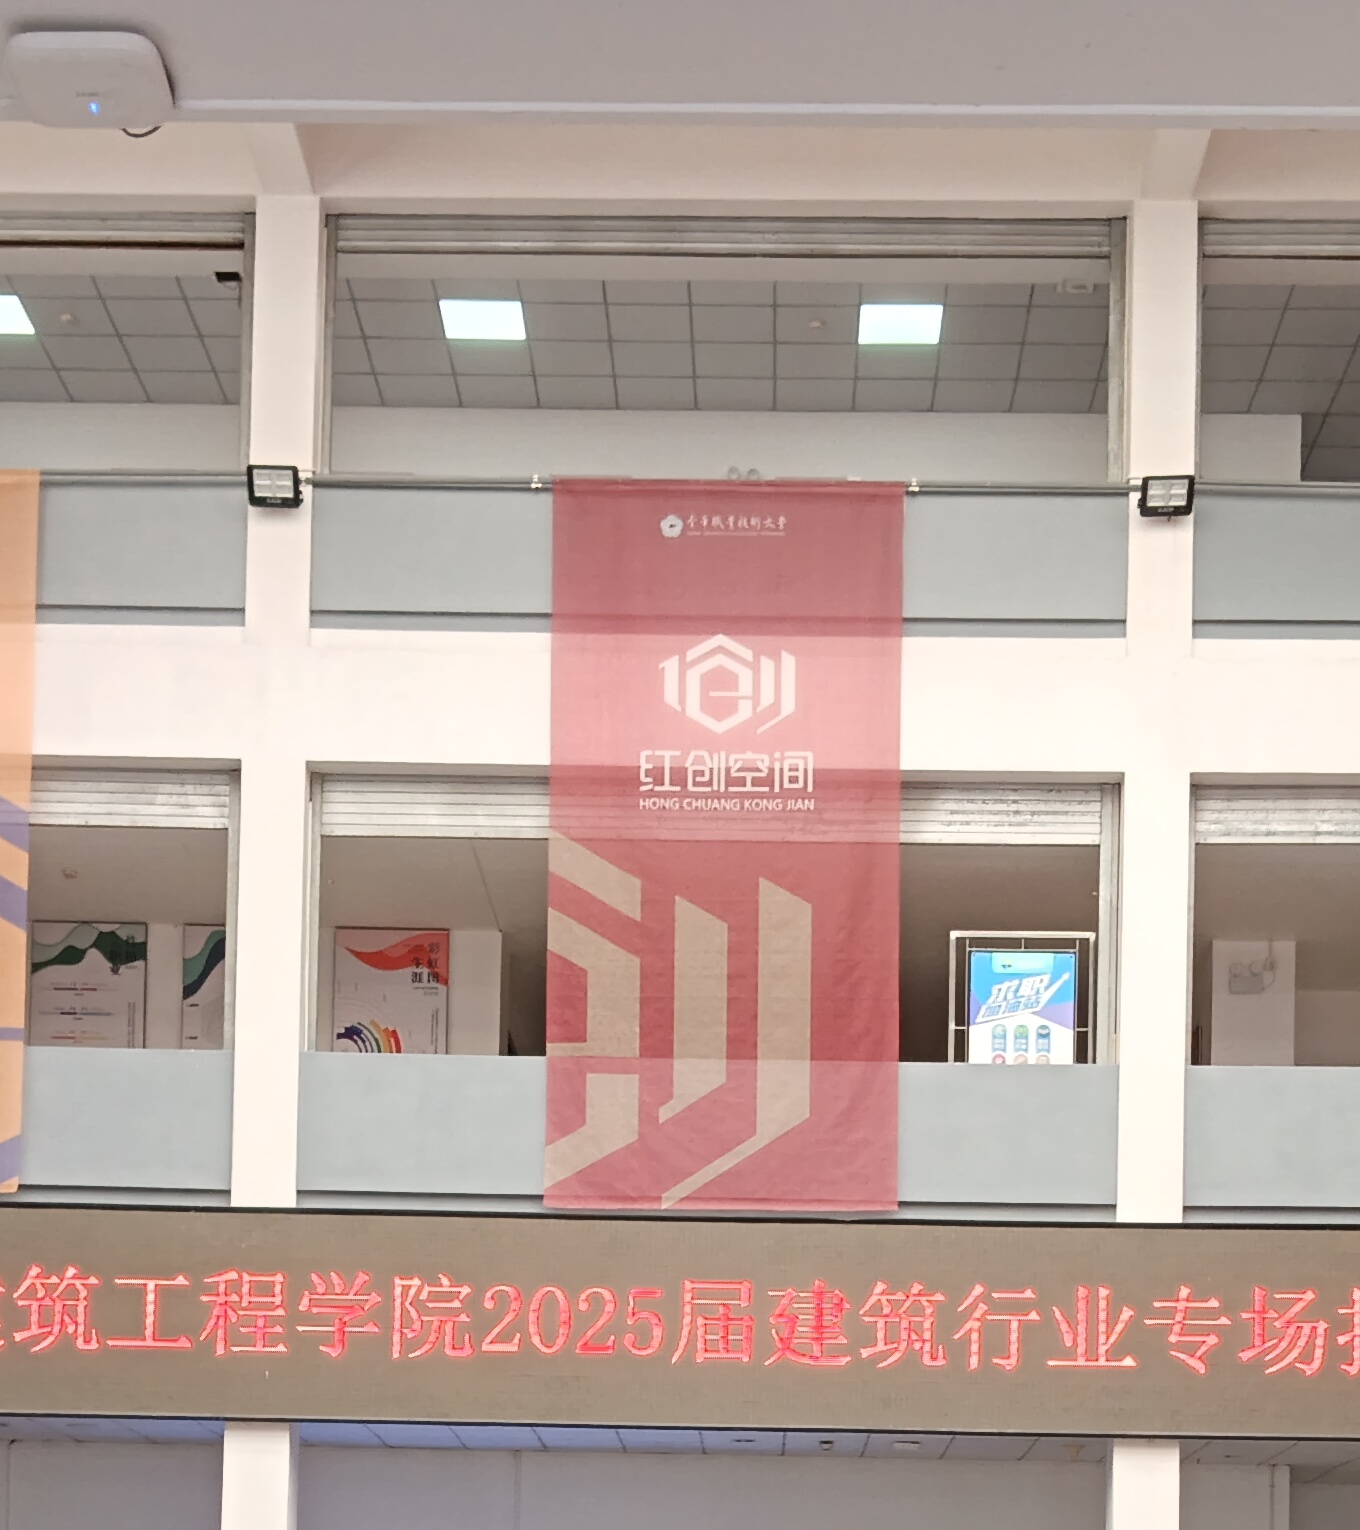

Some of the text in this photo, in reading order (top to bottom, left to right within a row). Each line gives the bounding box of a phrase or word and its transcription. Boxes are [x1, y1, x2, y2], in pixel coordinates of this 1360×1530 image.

[639, 749, 815, 793] 红创空间
[639, 798, 815, 812] HONG CHUANG KONG JIAN
